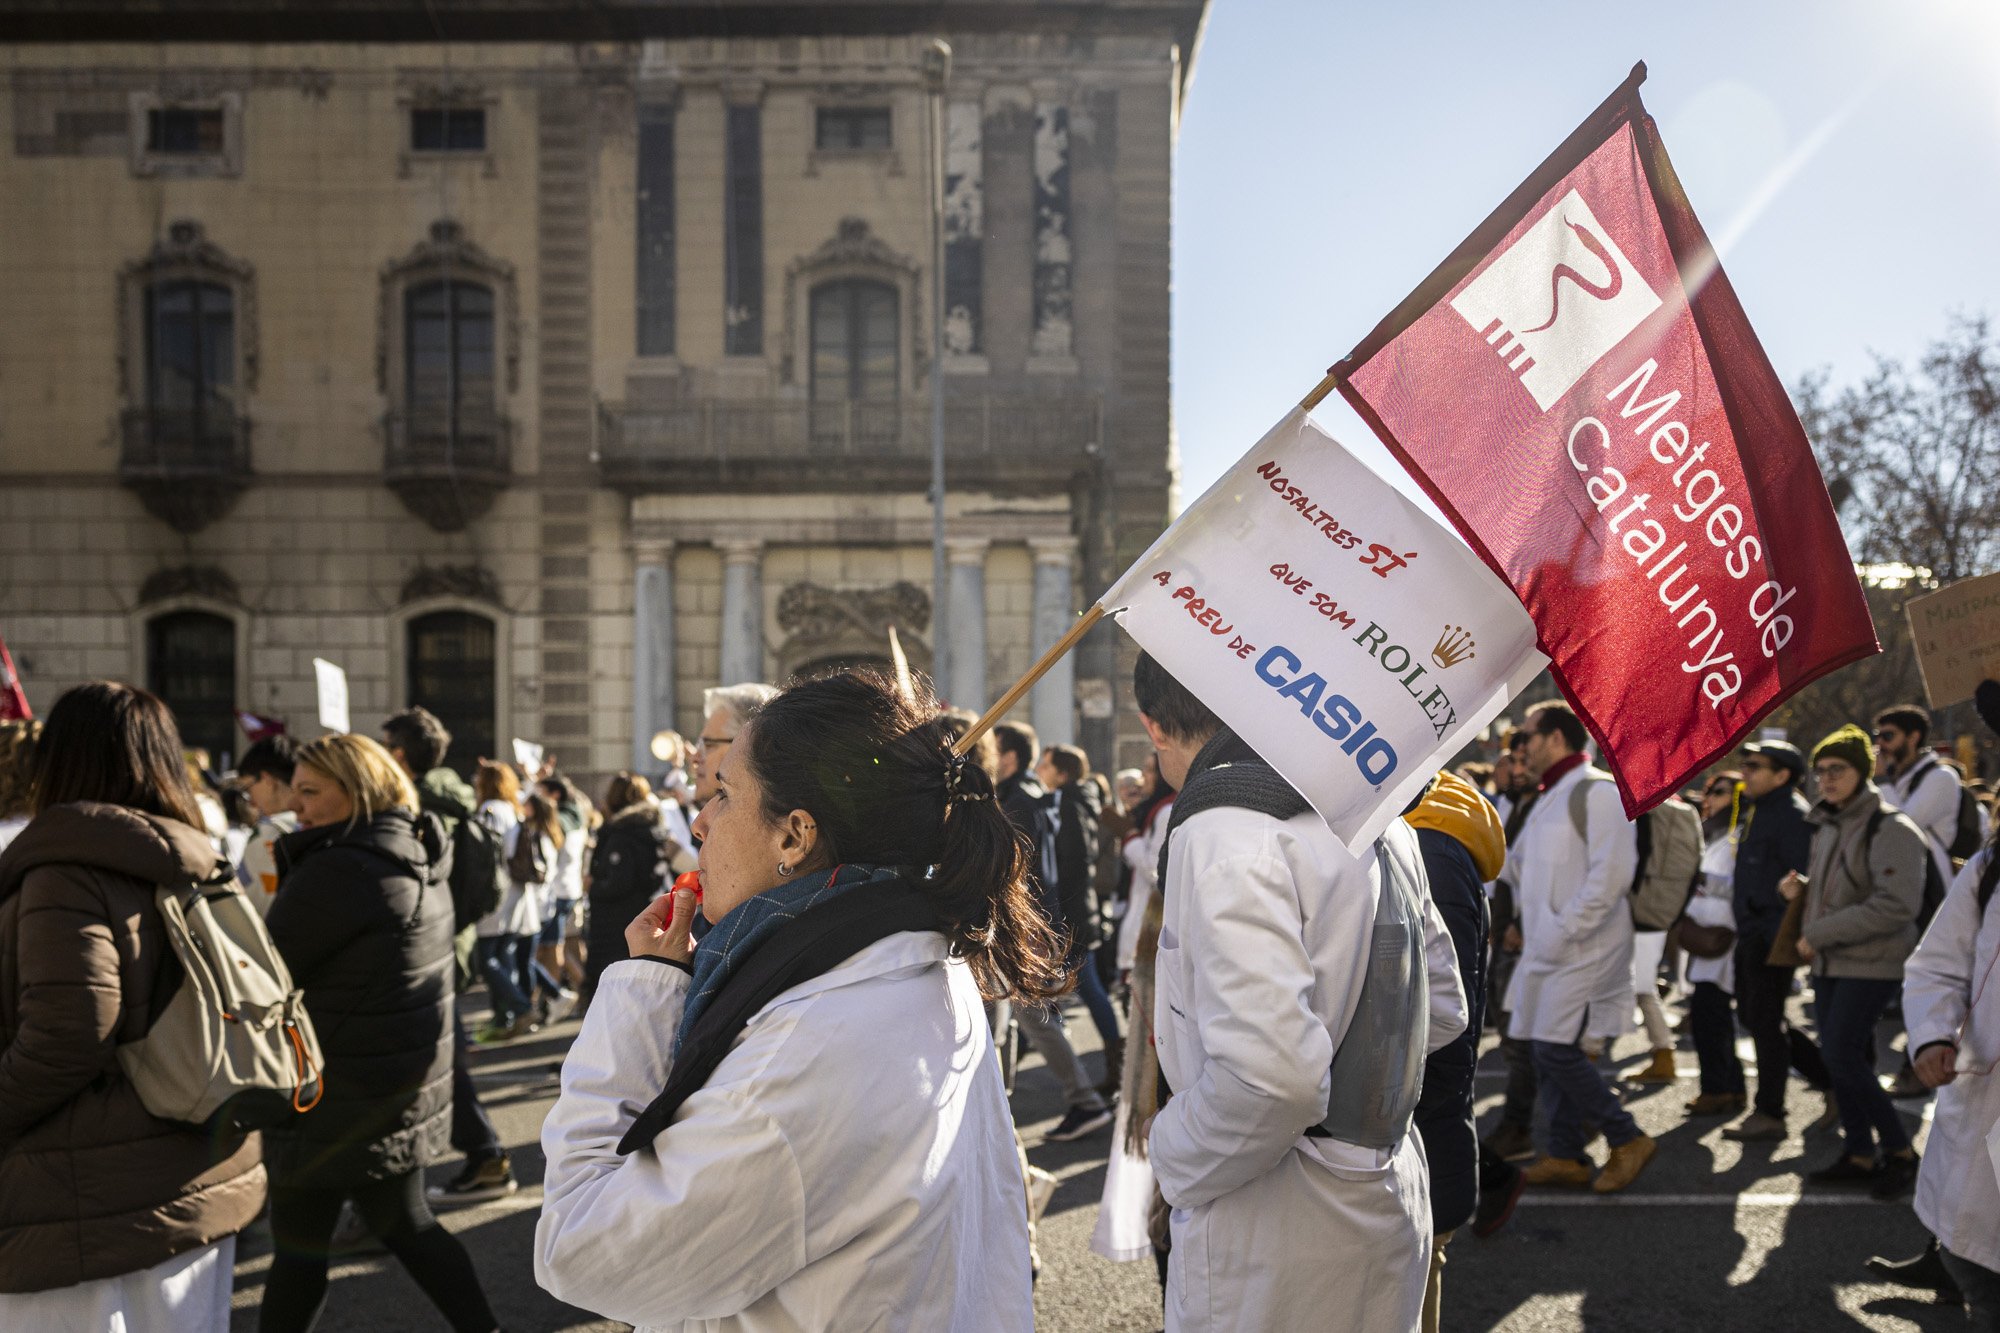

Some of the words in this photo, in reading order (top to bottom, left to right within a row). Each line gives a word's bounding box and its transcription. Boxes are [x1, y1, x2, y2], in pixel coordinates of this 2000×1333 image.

[1257, 461, 1362, 550] NOSALTRES
[1359, 542, 1418, 579] SÍ
[1567, 415, 1742, 710] Catalunya
[1606, 358, 1762, 580] Metges
[1748, 581, 1797, 660] de
[1153, 570, 1172, 587] A
[1172, 586, 1233, 637] PREU
[1228, 635, 1256, 660] DE
[1254, 645, 1397, 786] CASIO
[1270, 563, 1312, 595] QUE
[1309, 592, 1357, 630] SOM
[1353, 621, 1457, 741] ROLEX
